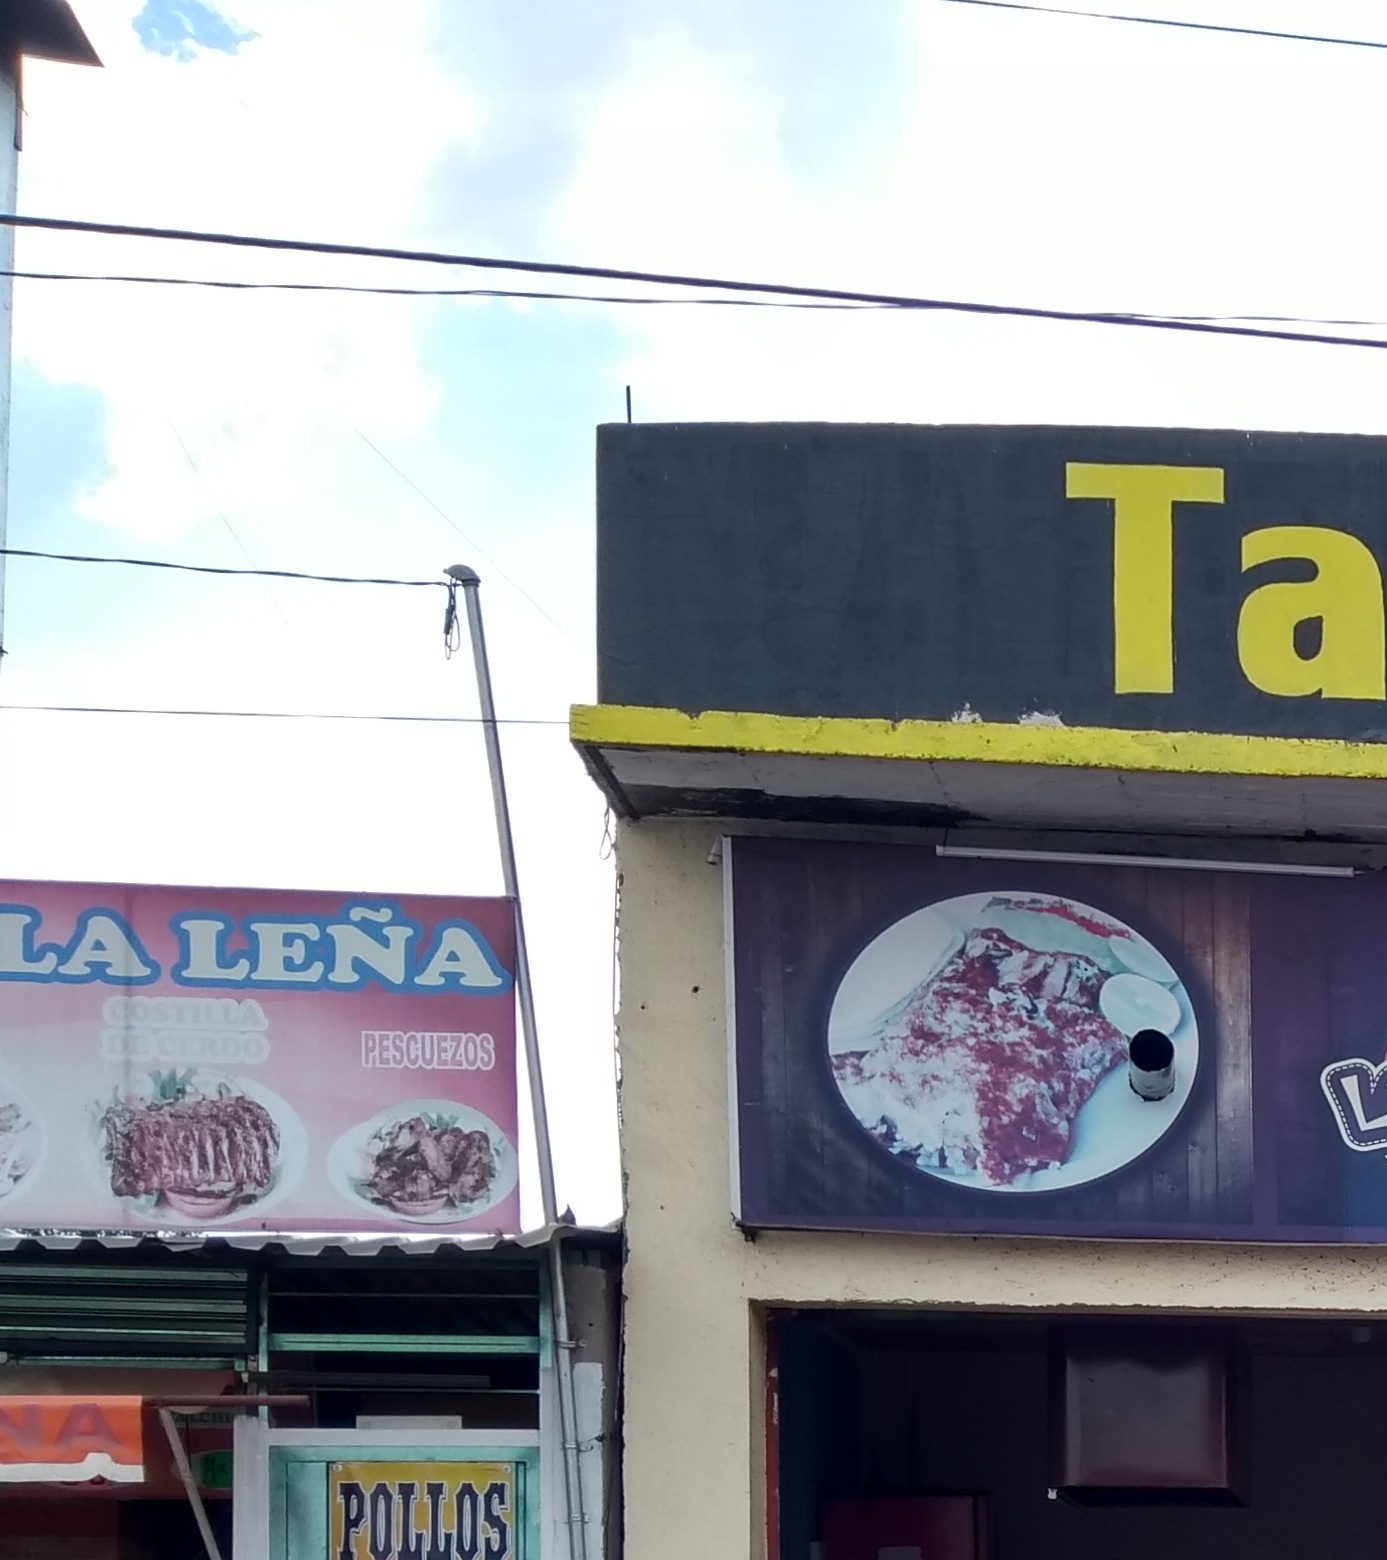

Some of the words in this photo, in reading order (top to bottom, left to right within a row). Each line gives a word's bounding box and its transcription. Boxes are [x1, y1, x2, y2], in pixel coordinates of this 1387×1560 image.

[0, 911, 152, 977] LA
[180, 907, 502, 987] LEÑA
[363, 1031, 496, 1070] PESCUEZOS
